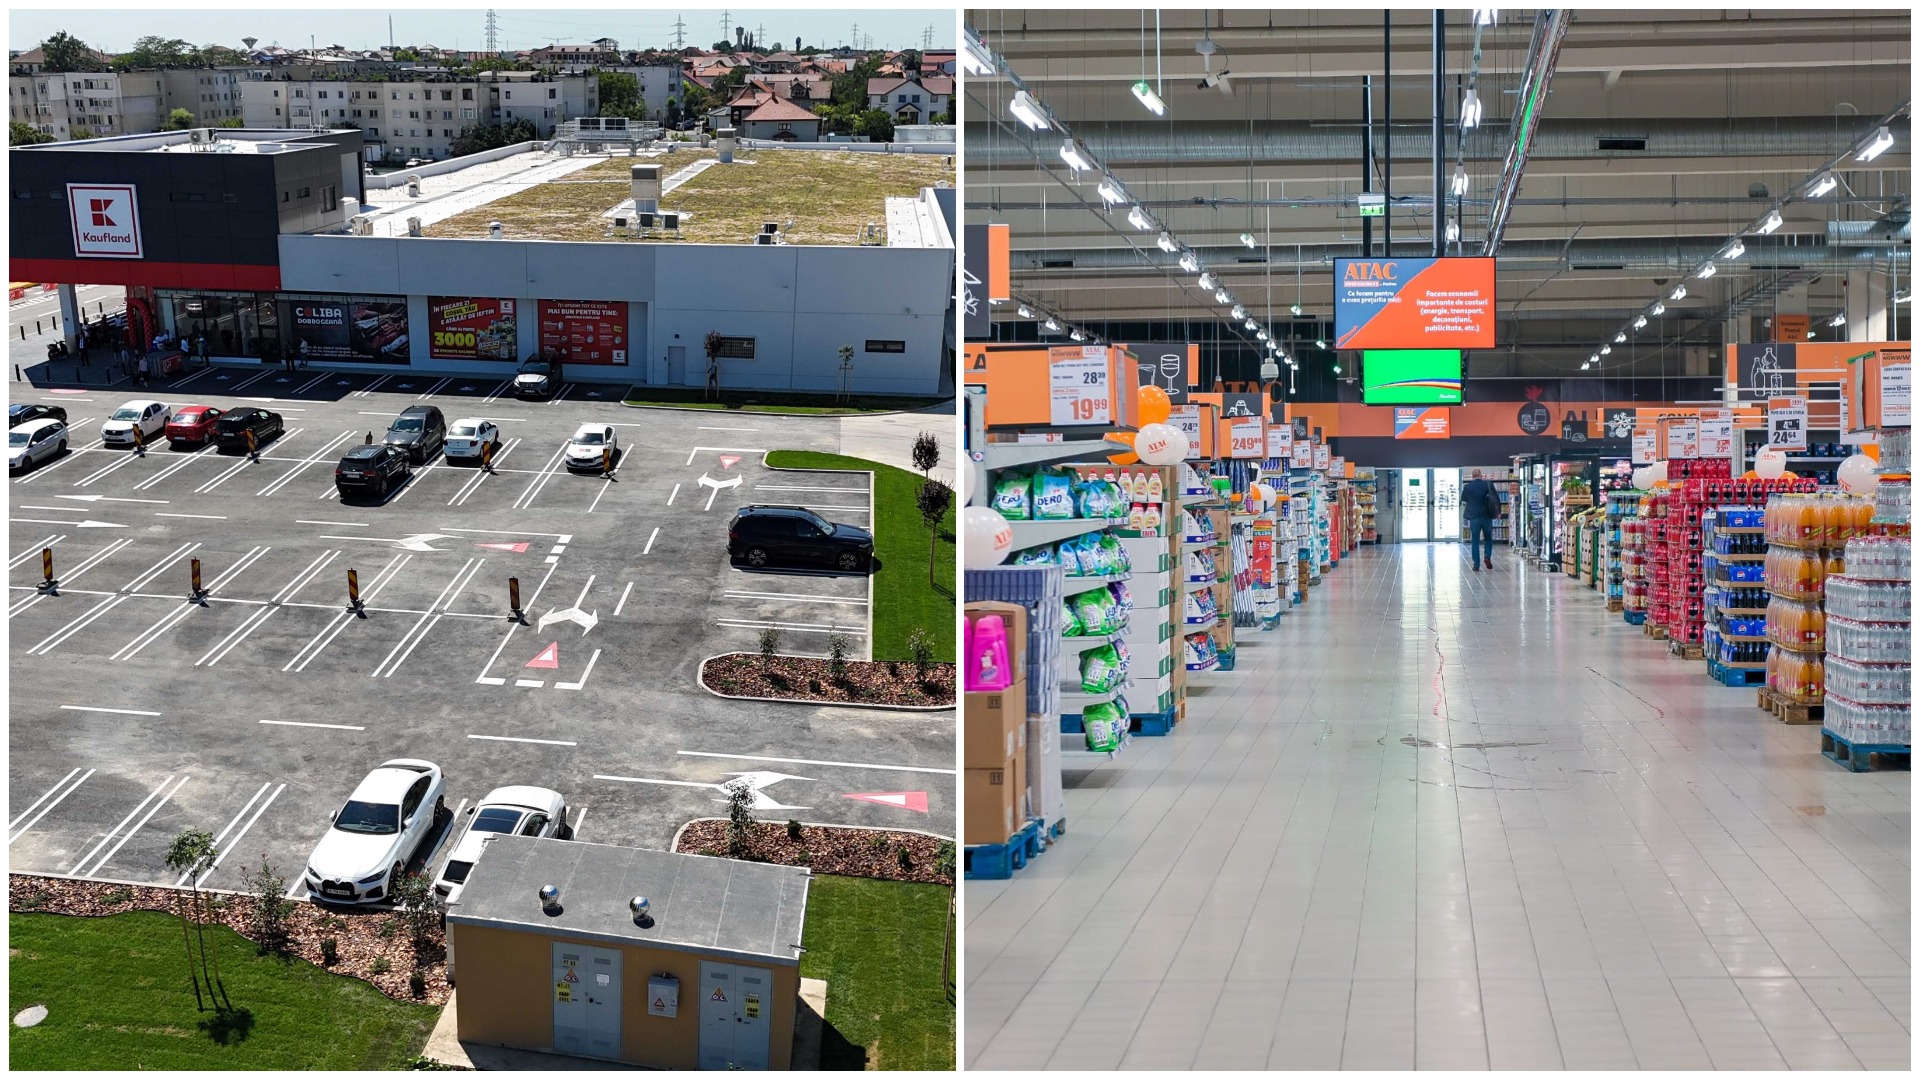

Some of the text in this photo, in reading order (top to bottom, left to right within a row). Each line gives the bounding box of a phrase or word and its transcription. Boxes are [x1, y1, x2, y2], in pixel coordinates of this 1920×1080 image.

[82, 232, 131, 243] Kaufland
[1344, 262, 1398, 280] ATAC
[1374, 290, 1395, 298] pentru
[440, 301, 463, 312] FIECARE
[1416, 299, 1454, 307] importante
[295, 306, 342, 318] COLIBA
[476, 308, 495, 318] IEFTIN
[1420, 307, 1484, 316] (energie, transport,
[1424, 324, 1480, 333] publicitate, etc.)
[434, 331, 475, 347] 3000
[1037, 494, 1063, 506] DERO
